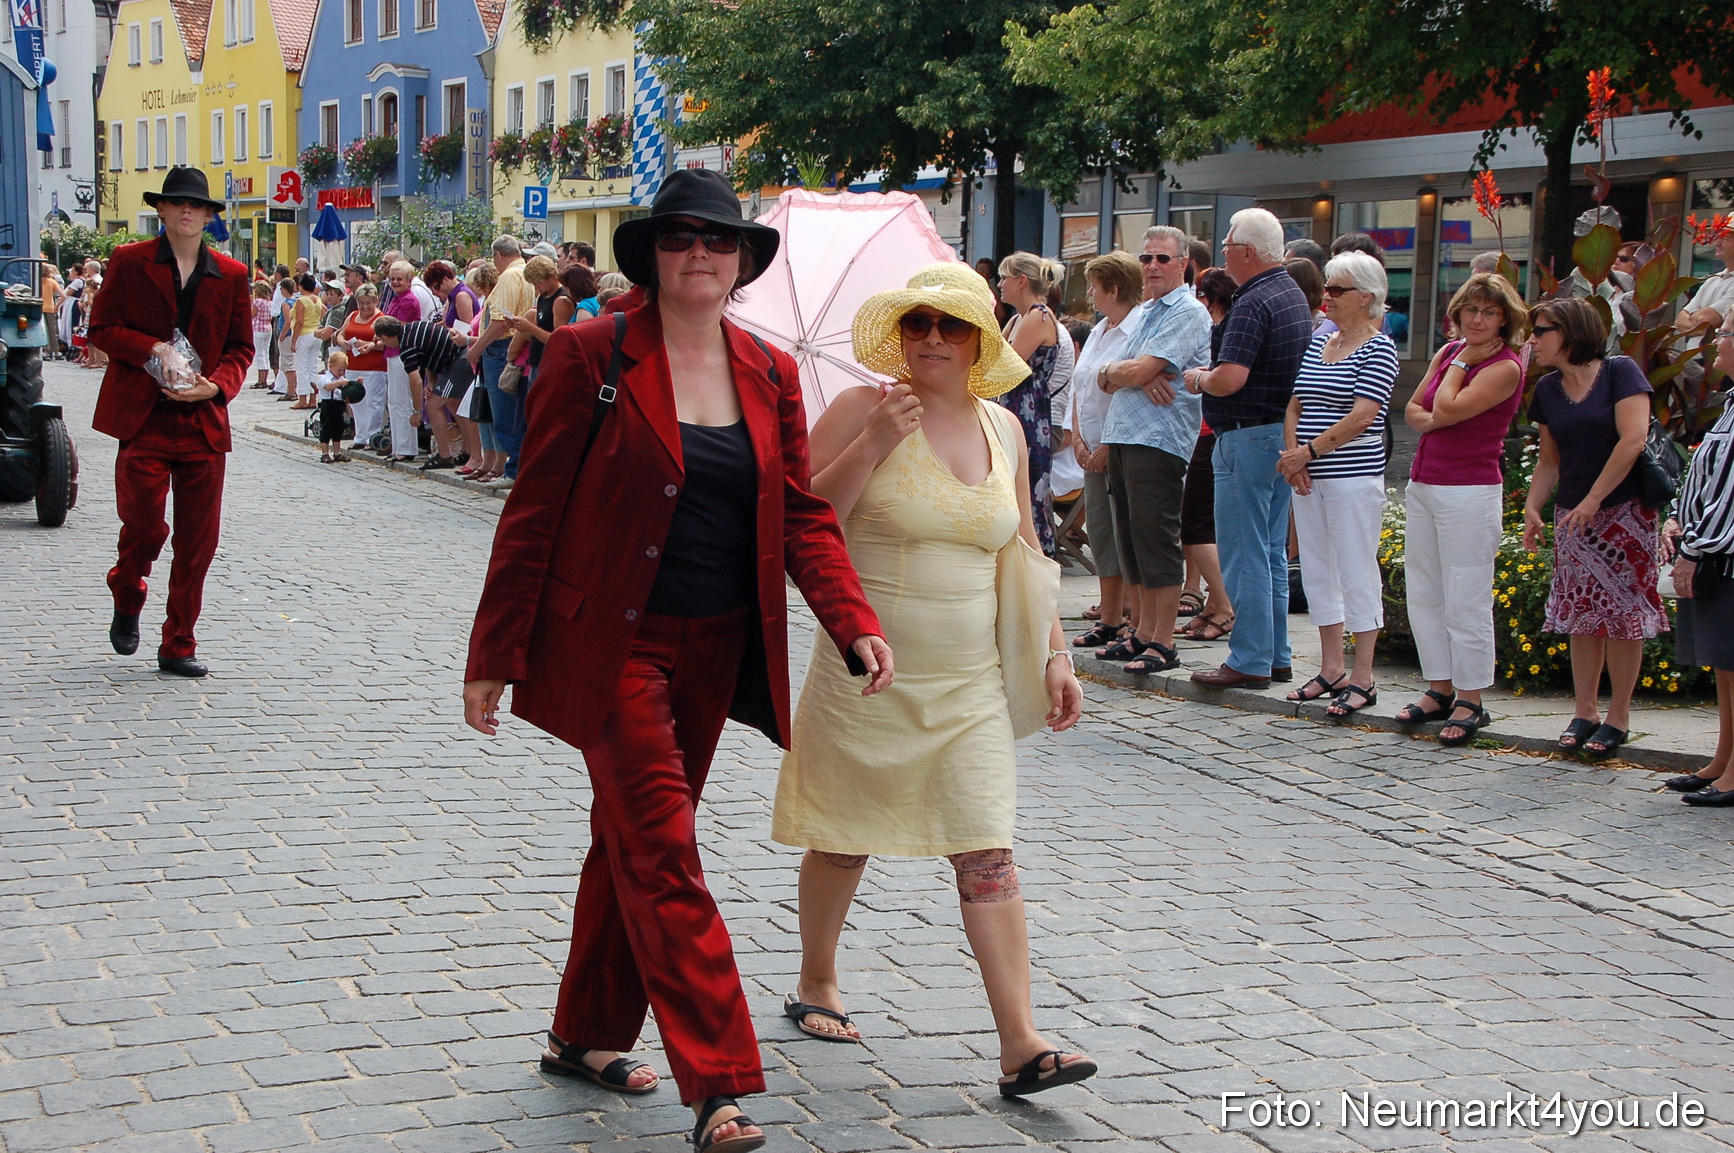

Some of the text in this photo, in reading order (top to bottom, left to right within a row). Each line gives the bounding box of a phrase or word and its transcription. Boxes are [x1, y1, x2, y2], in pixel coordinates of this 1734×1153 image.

[142, 87, 197, 110] HOTEL Lehmeier
[471, 126, 483, 191] WITTL
[226, 177, 231, 197] P
[529, 190, 543, 215] P
